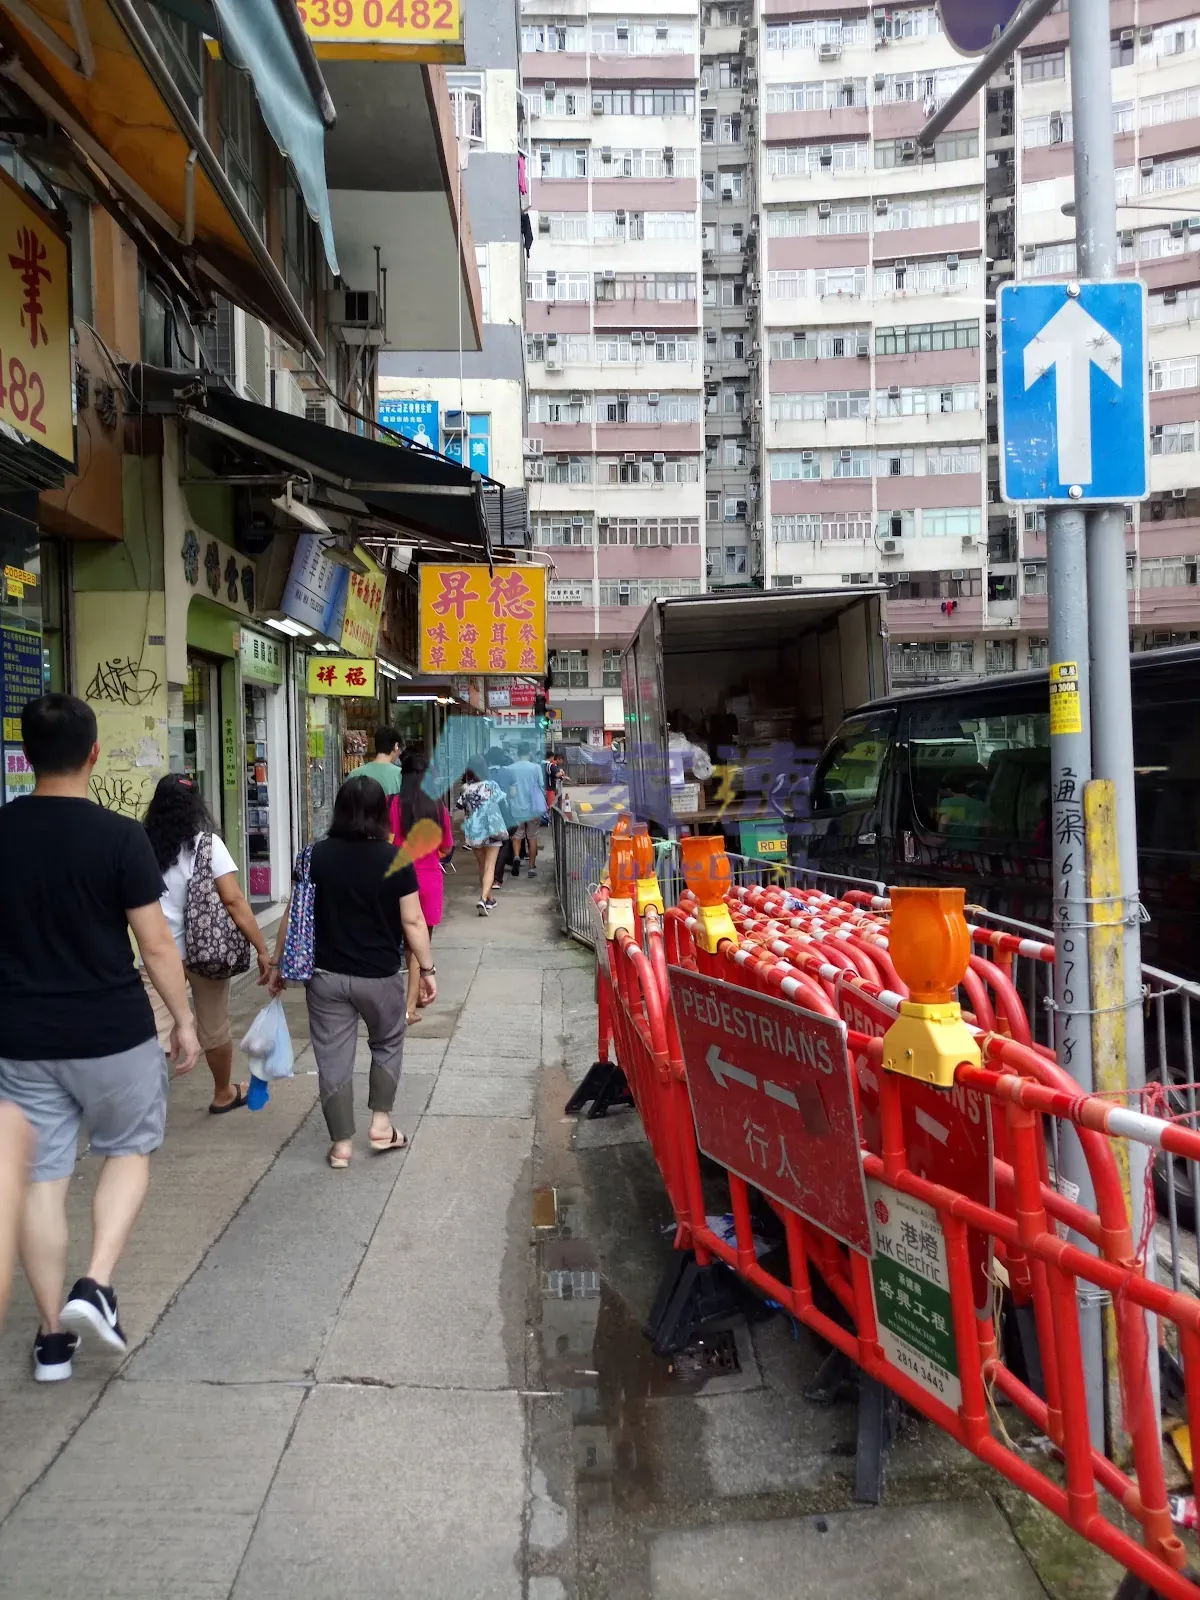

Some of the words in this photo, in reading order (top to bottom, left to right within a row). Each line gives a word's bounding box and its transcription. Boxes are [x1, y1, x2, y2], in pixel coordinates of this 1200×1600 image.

[363, 0, 453, 29] 0482
[316, 665, 367, 687] 祥福
[607, 674, 617, 686] 5
[760, 841, 775, 851] RD
[681, 988, 833, 1075] PEDESTRIANS
[742, 1117, 801, 1188] 行人
[876, 1231, 894, 1256] HK
[896, 1242, 942, 1284] Electric
[900, 1220, 940, 1262] 港燈
[879, 1278, 950, 1336] 培興工程
[894, 1311, 937, 1345] CONTRACTOR
[896, 1349, 919, 1373] 2814
[920, 1367, 944, 1392] 3443
